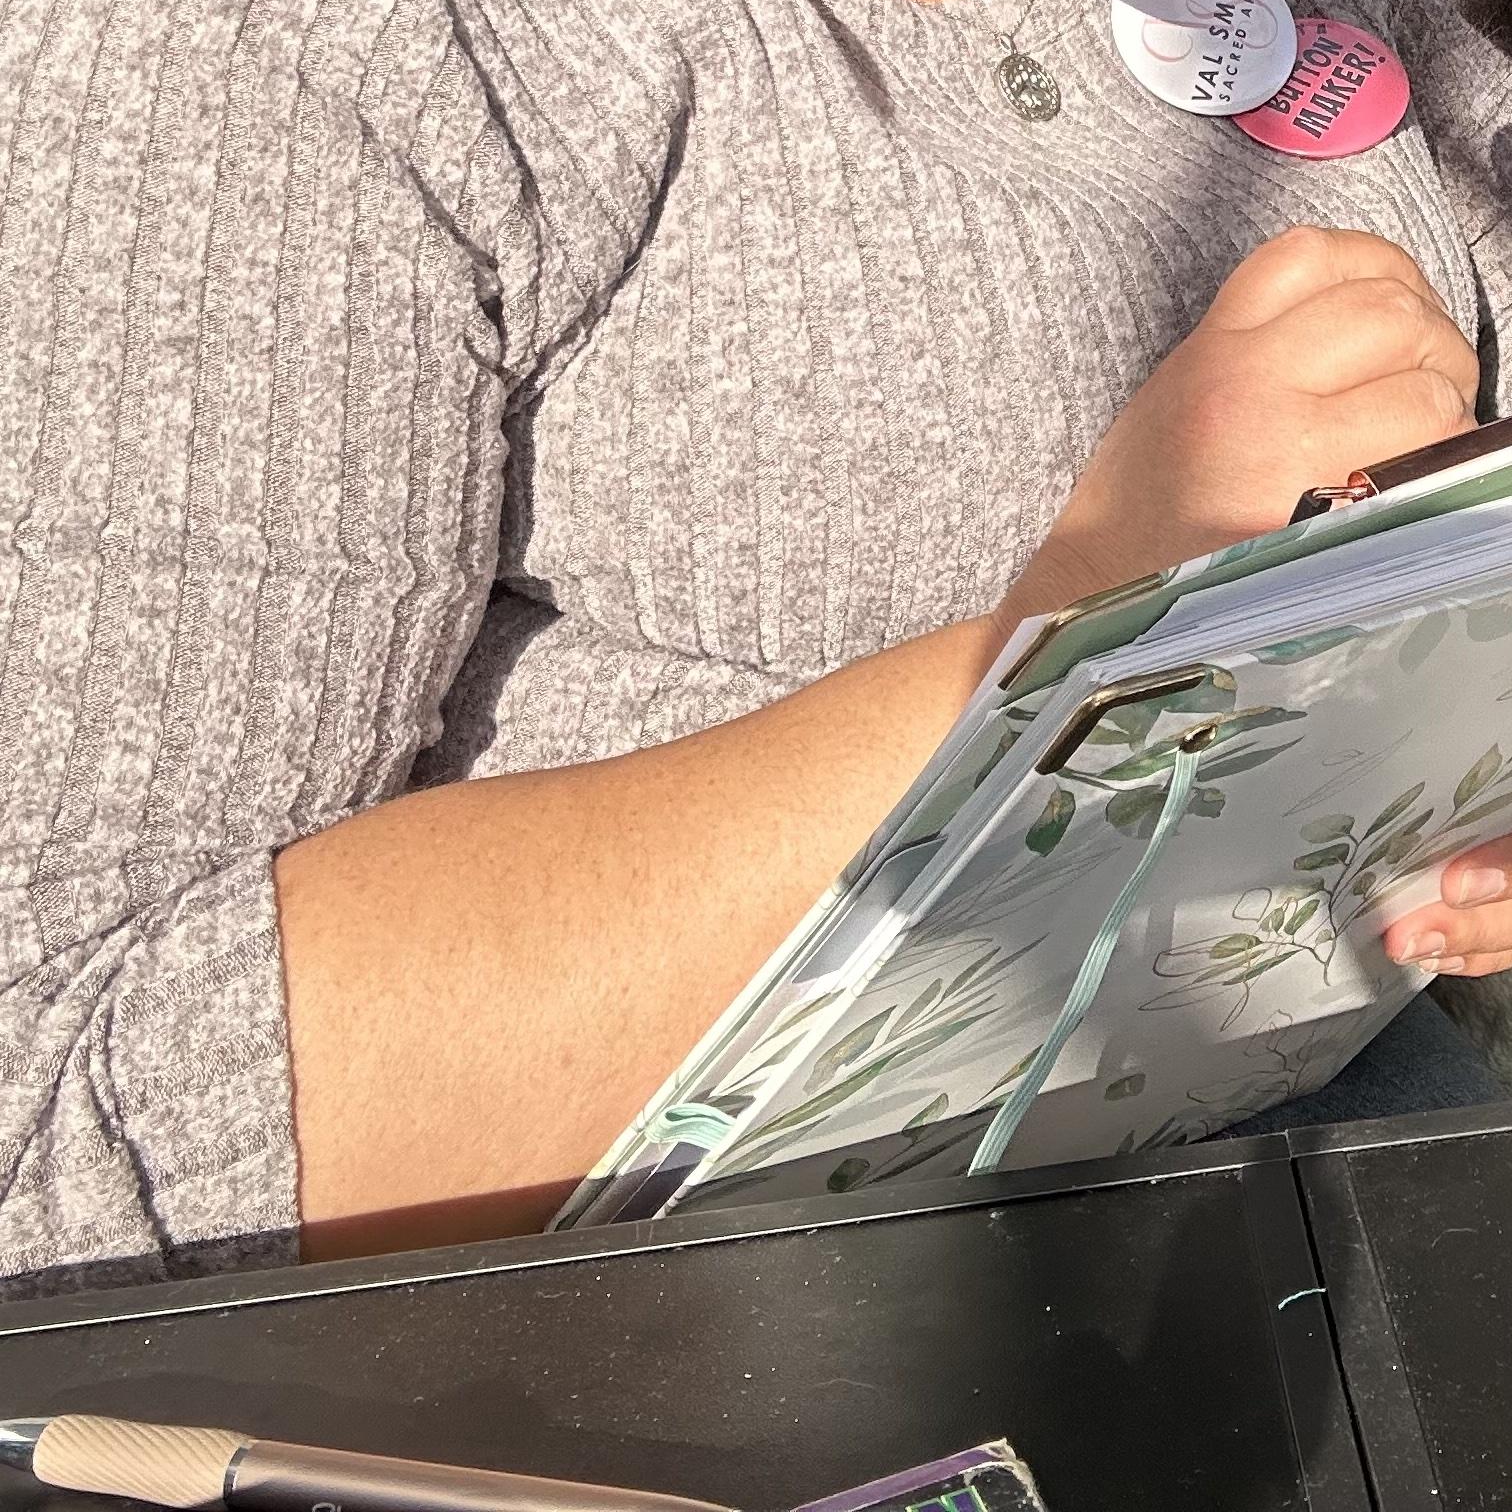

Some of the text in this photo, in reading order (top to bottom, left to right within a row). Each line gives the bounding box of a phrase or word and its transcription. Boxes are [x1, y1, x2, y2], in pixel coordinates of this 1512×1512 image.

[1191, 54, 1224, 103] VAL
[1218, 28, 1248, 103] SACRED
[1292, 40, 1387, 140] MAKER!
